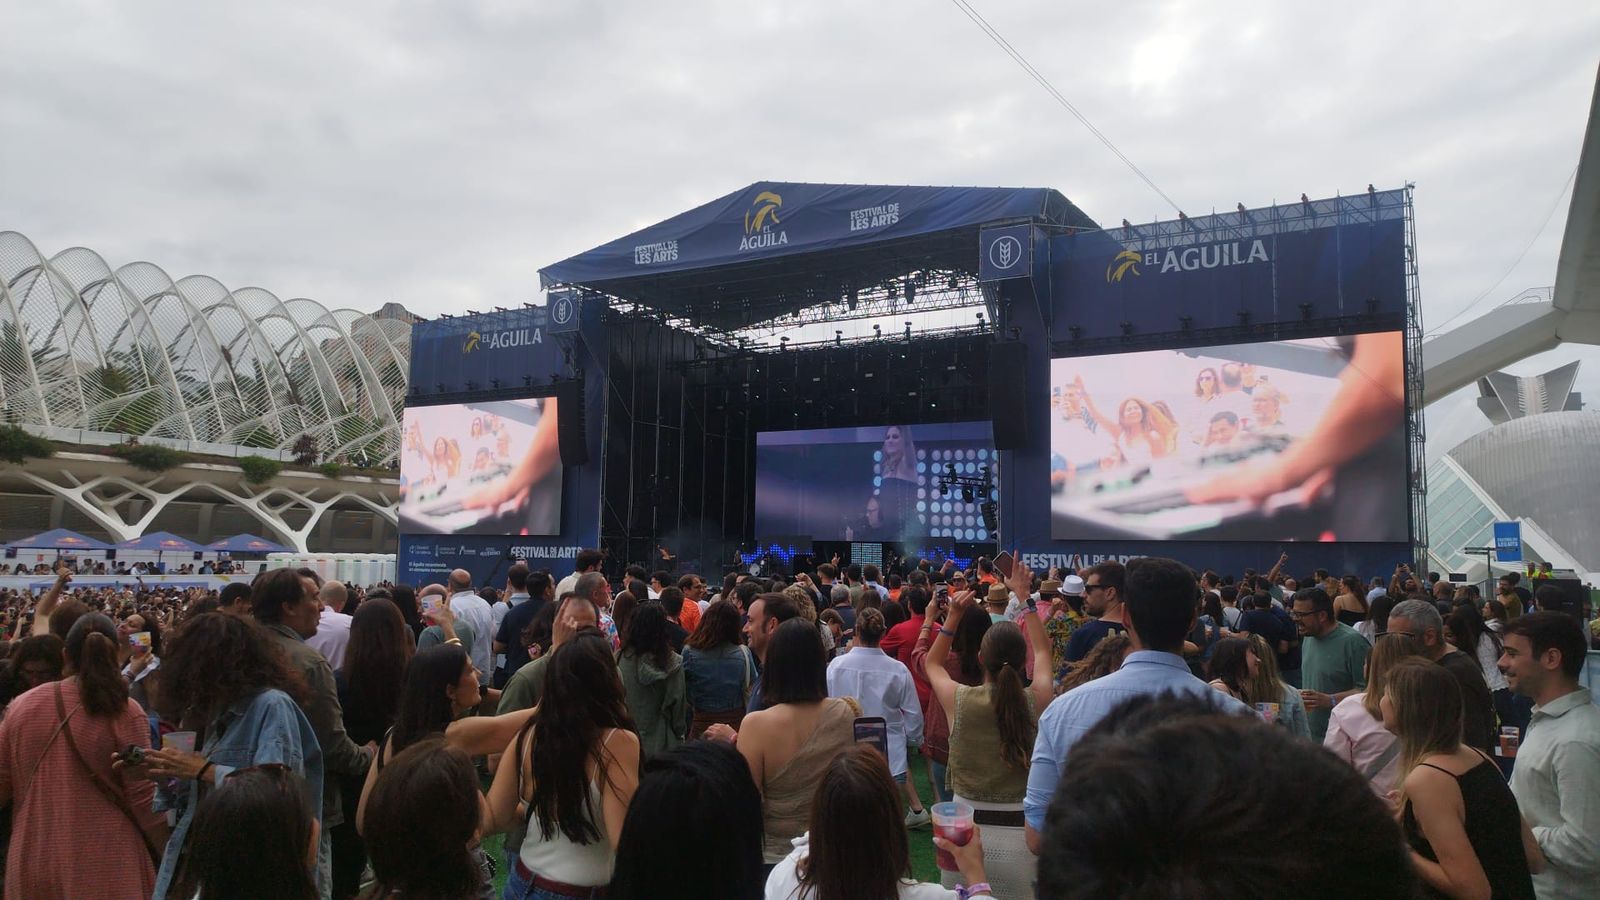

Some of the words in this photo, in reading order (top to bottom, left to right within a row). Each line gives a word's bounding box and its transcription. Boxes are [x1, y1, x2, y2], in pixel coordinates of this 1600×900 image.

[851, 205, 887, 219] FESTIVAL
[888, 203, 900, 214] DE
[763, 225, 772, 233] EL
[851, 218, 869, 231] LES
[871, 214, 899, 227] ARTS
[634, 242, 667, 254] FESTIVAL
[668, 240, 679, 250] DE
[634, 252, 651, 265] LES
[653, 249, 679, 263] ARTS
[1145, 252, 1160, 266] EL
[1160, 239, 1269, 274] ÁGUILA
[481, 334, 490, 343] EL
[510, 546, 549, 559] FESTIVAL
[1022, 553, 1089, 569] FESTIVAL
[1093, 554, 1105, 563] DE
